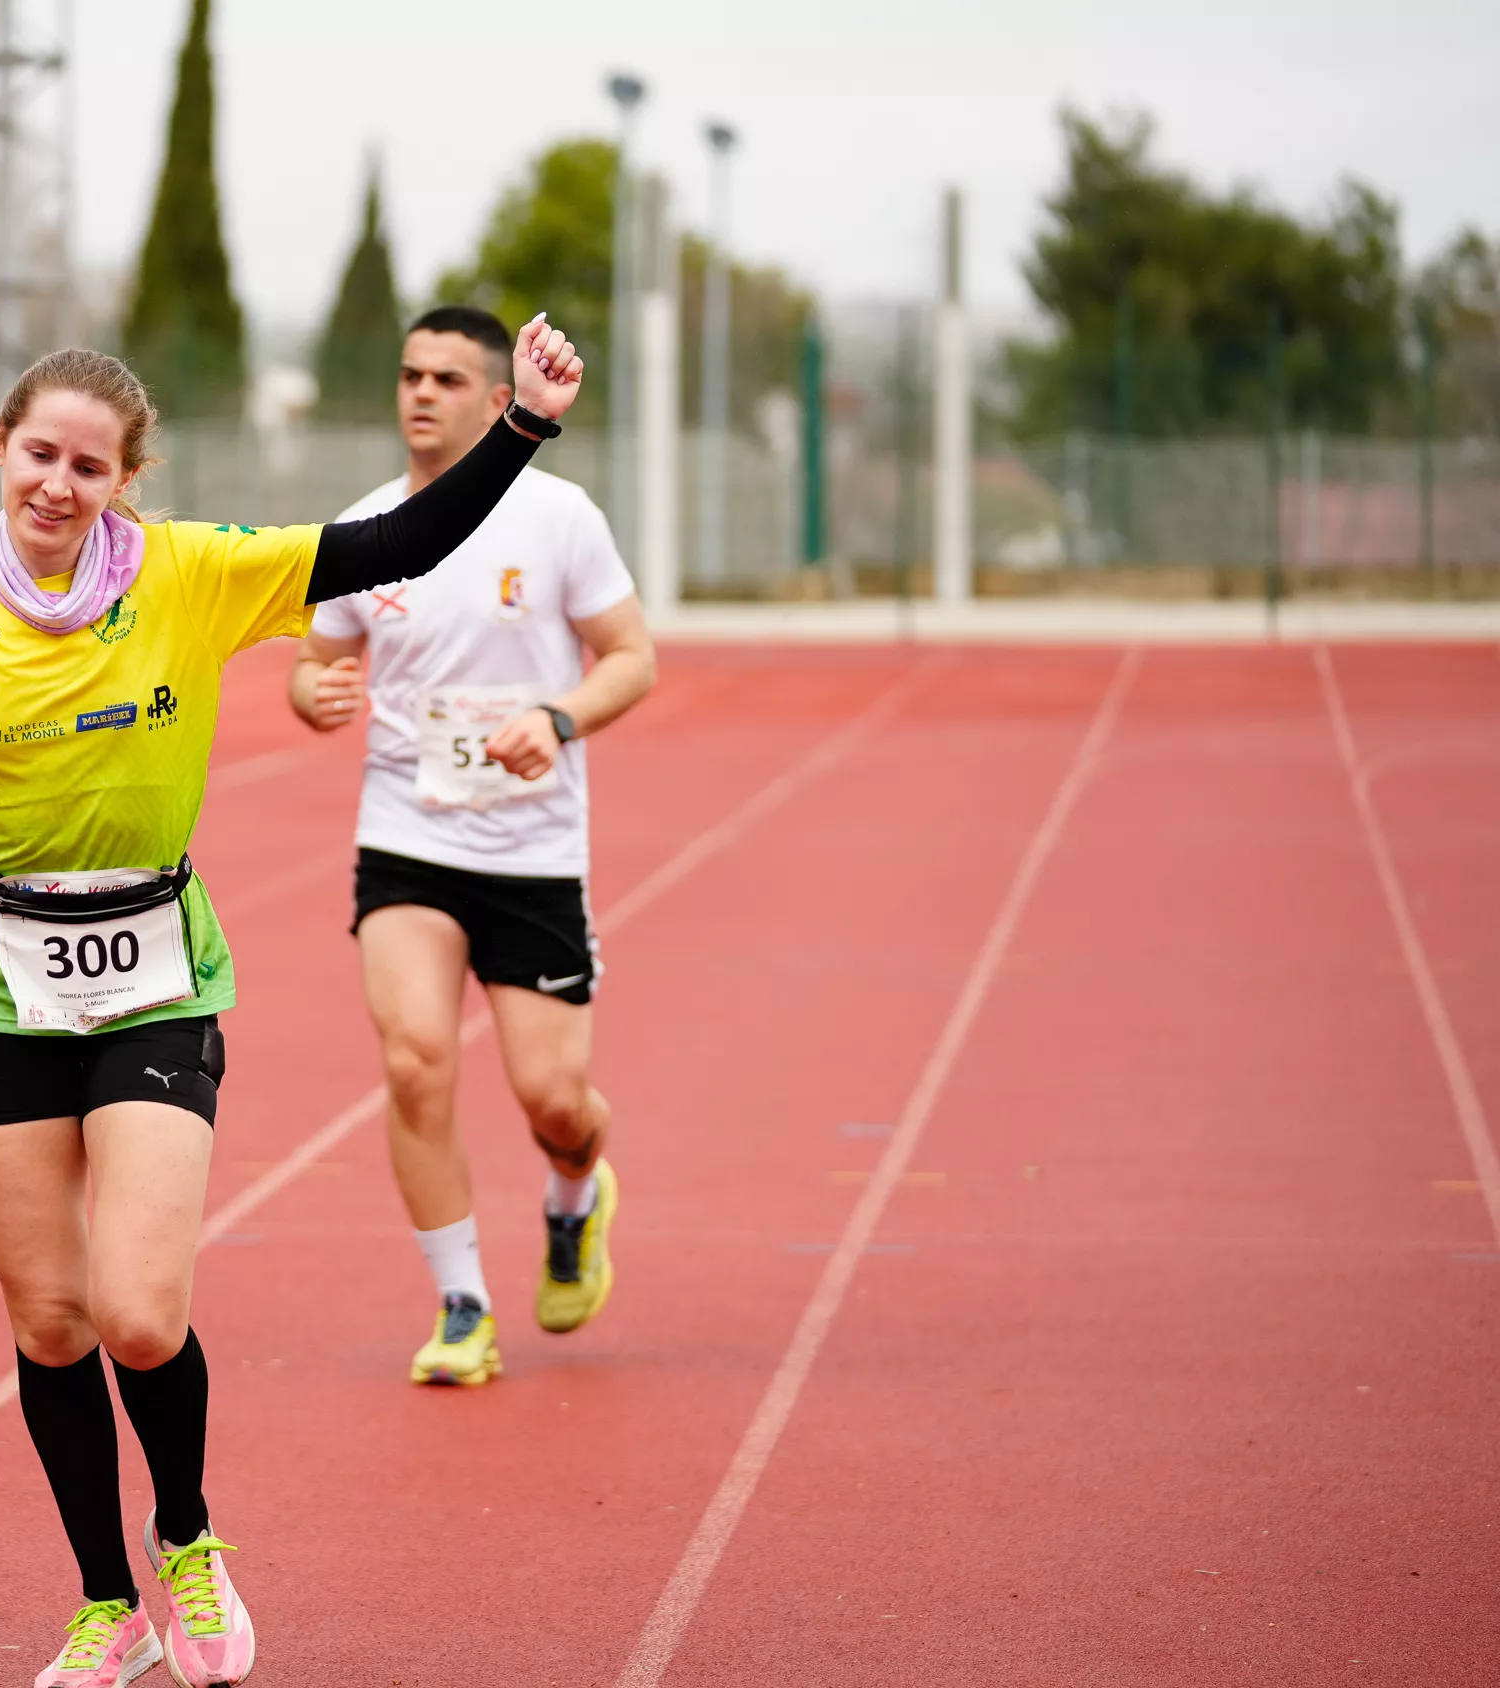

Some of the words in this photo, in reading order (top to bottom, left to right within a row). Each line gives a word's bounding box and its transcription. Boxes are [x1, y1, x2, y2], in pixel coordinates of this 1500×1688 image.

[9, 720, 58, 732] BODEGAS
[148, 715, 178, 731] RIADA
[4, 733, 17, 743] EL
[21, 727, 65, 741] MONTE
[43, 930, 139, 979] 300
[83, 989, 106, 999] FLORES
